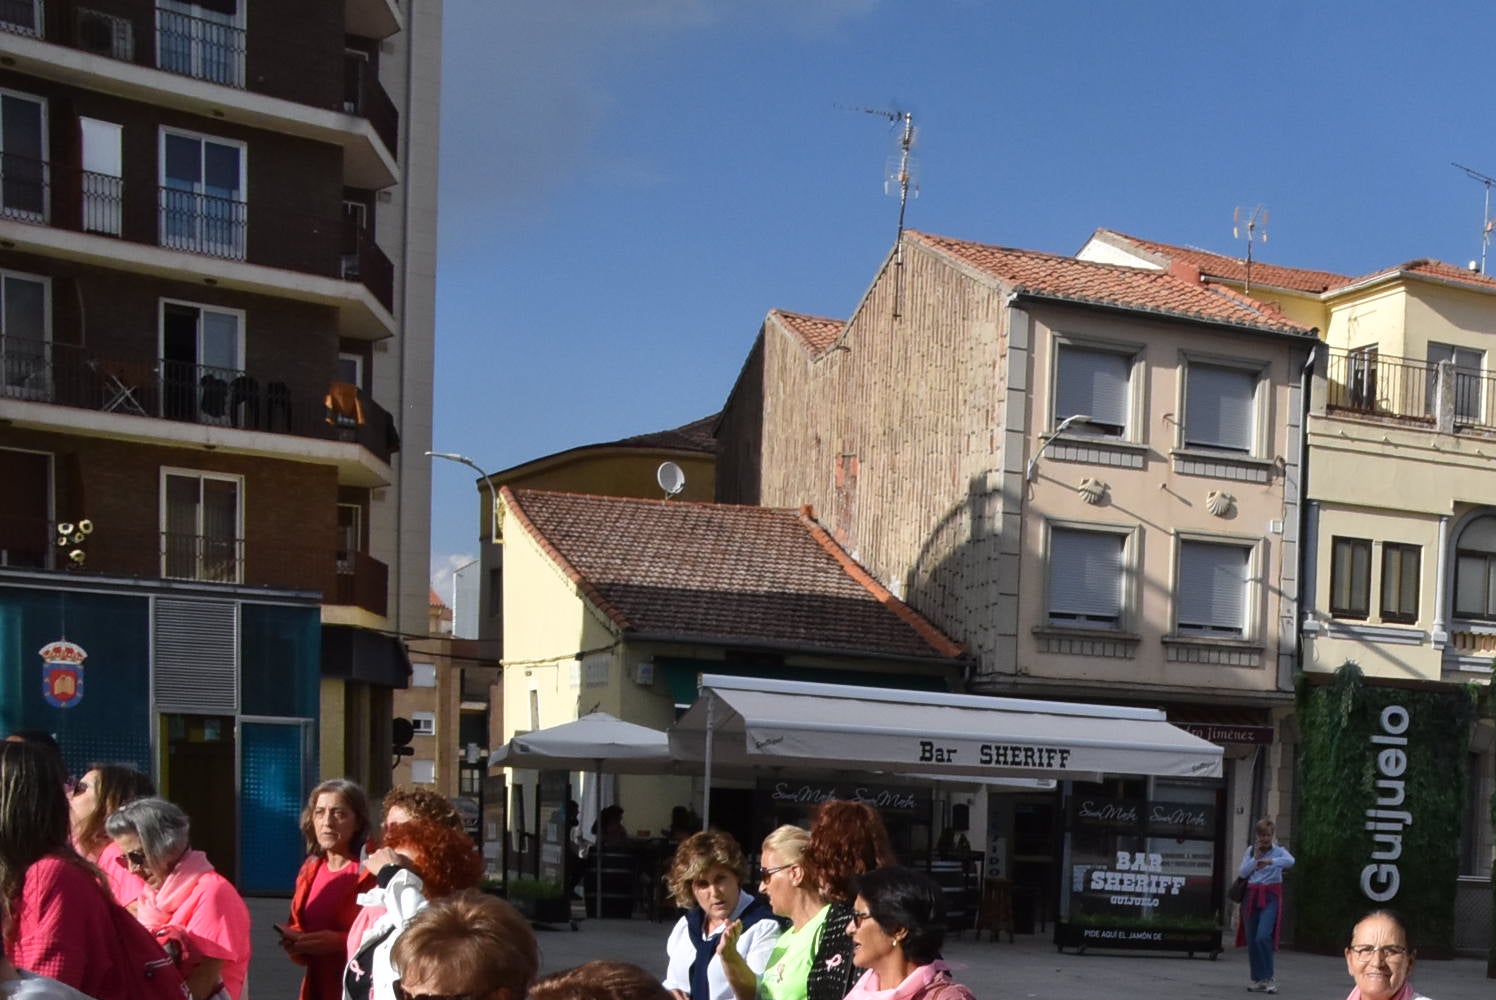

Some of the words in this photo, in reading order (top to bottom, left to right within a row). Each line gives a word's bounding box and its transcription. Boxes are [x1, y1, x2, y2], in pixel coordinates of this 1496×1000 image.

[920, 741, 957, 763] Bar
[980, 744, 1071, 768] SHERIFF
[1360, 705, 1413, 902] Guijuelo
[1116, 851, 1163, 872] BAR
[1091, 871, 1186, 895] SHERIFF
[1084, 929, 1100, 938] PIDE
[1118, 931, 1126, 939] EL
[1153, 933, 1162, 941] DE
